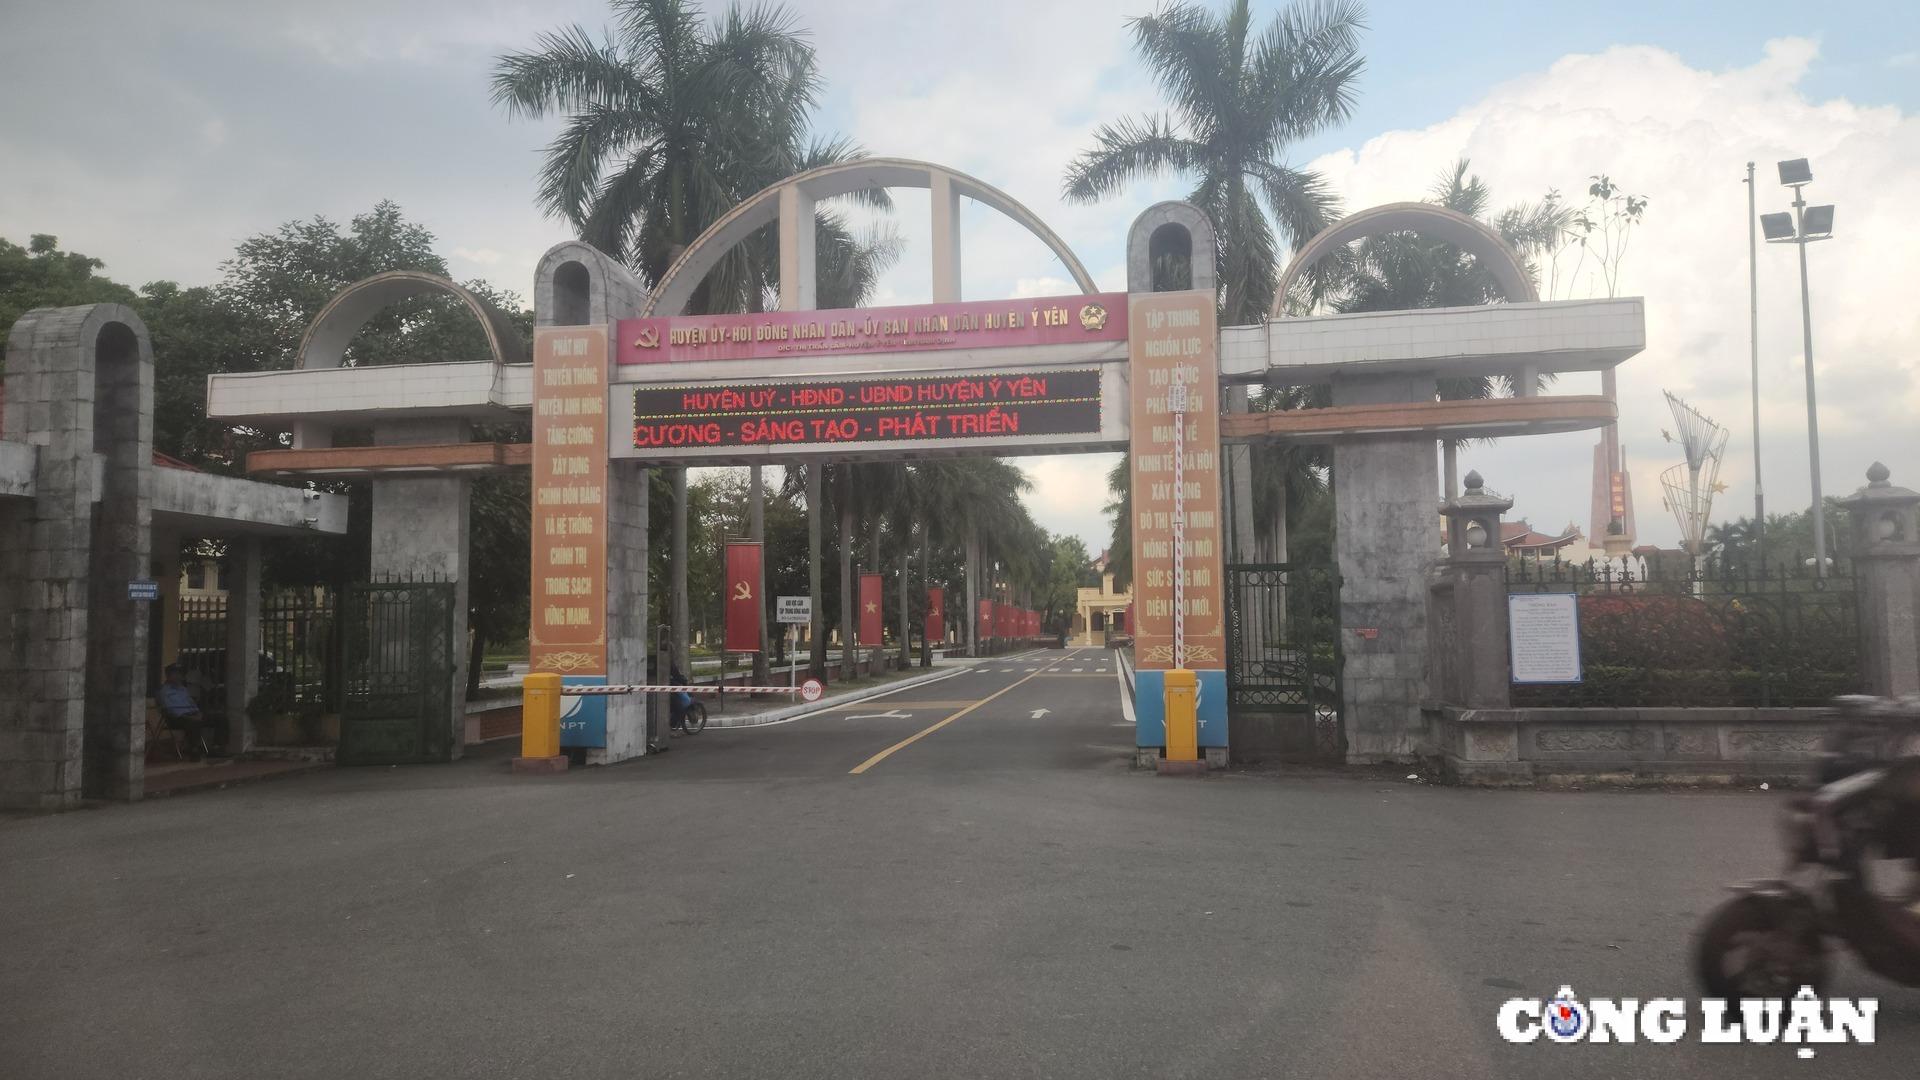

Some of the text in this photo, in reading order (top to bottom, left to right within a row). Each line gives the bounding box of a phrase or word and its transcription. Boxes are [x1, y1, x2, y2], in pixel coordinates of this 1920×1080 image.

[883, 317, 908, 334] BAN
[1031, 307, 1038, 327] Ý
[1044, 306, 1068, 325] YÊN
[1145, 308, 1200, 332] TẬP TRUNG
[1148, 368, 1168, 389] TẠO
[683, 389, 745, 410] HUYỆN
[791, 387, 844, 407] HĐND
[860, 385, 913, 404] UBND
[917, 379, 984, 401] HUYỆN
[1007, 377, 1047, 398] YÊN
[564, 397, 580, 415] ANH
[741, 418, 805, 442] SÁNG
[810, 418, 859, 443] TẠO
[879, 412, 940, 437] PHÁT
[947, 405, 1018, 434] TRIỂN
[1152, 426, 1176, 446] MẠN
[552, 454, 567, 475] XÂY
[1138, 454, 1161, 472] KINH
[1163, 449, 1174, 471] TẾ
[1151, 480, 1170, 500] XÂY
[1154, 512, 1168, 533] THỊ
[1170, 511, 1187, 529] VN
[1190, 511, 1214, 529] MINH
[574, 547, 587, 568] TRỊ
[1143, 538, 1168, 558] NÔNG
[1146, 566, 1164, 587] SỨC
[544, 577, 592, 599] TRONG SẠCH
[1146, 596, 1167, 620] DIỆN
[804, 686, 821, 695] STOP
